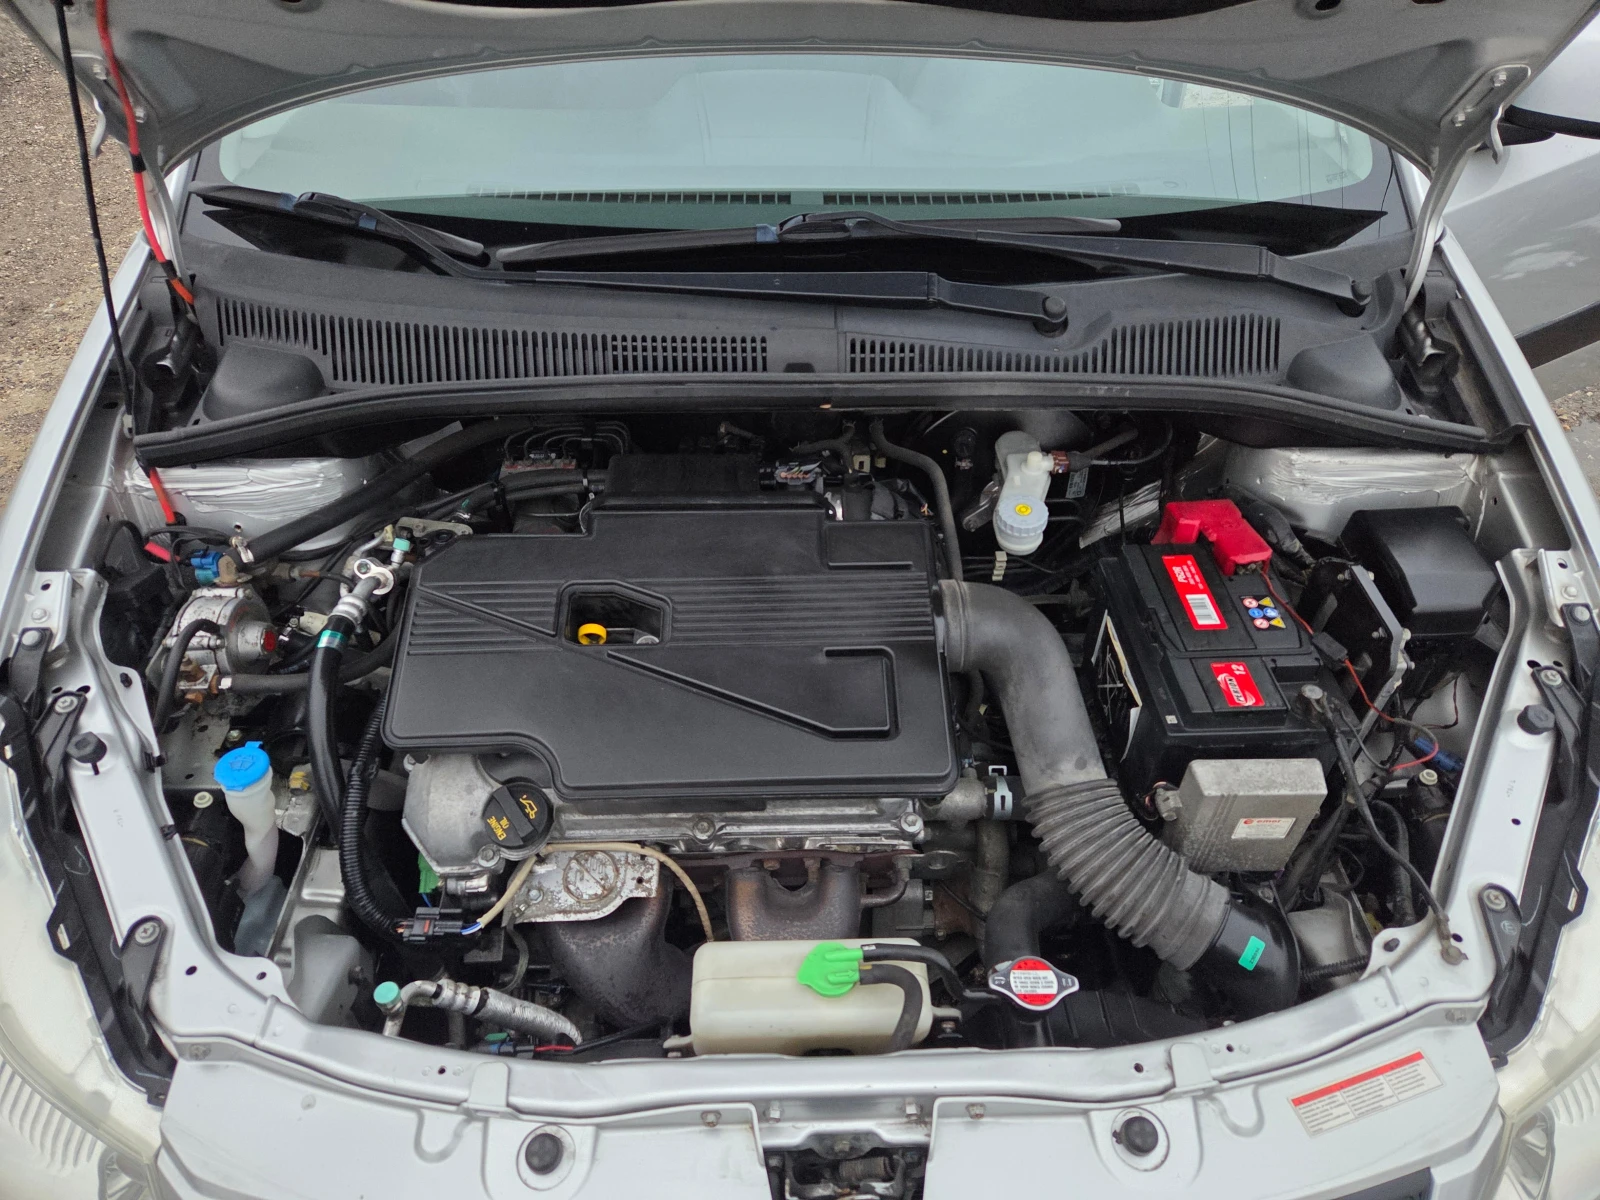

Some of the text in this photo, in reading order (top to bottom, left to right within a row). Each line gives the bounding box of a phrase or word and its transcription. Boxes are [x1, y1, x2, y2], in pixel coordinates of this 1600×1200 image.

[1227, 678, 1243, 702] PERION
[487, 816, 506, 840] ENGINE
[500, 816, 509, 829] OIL
